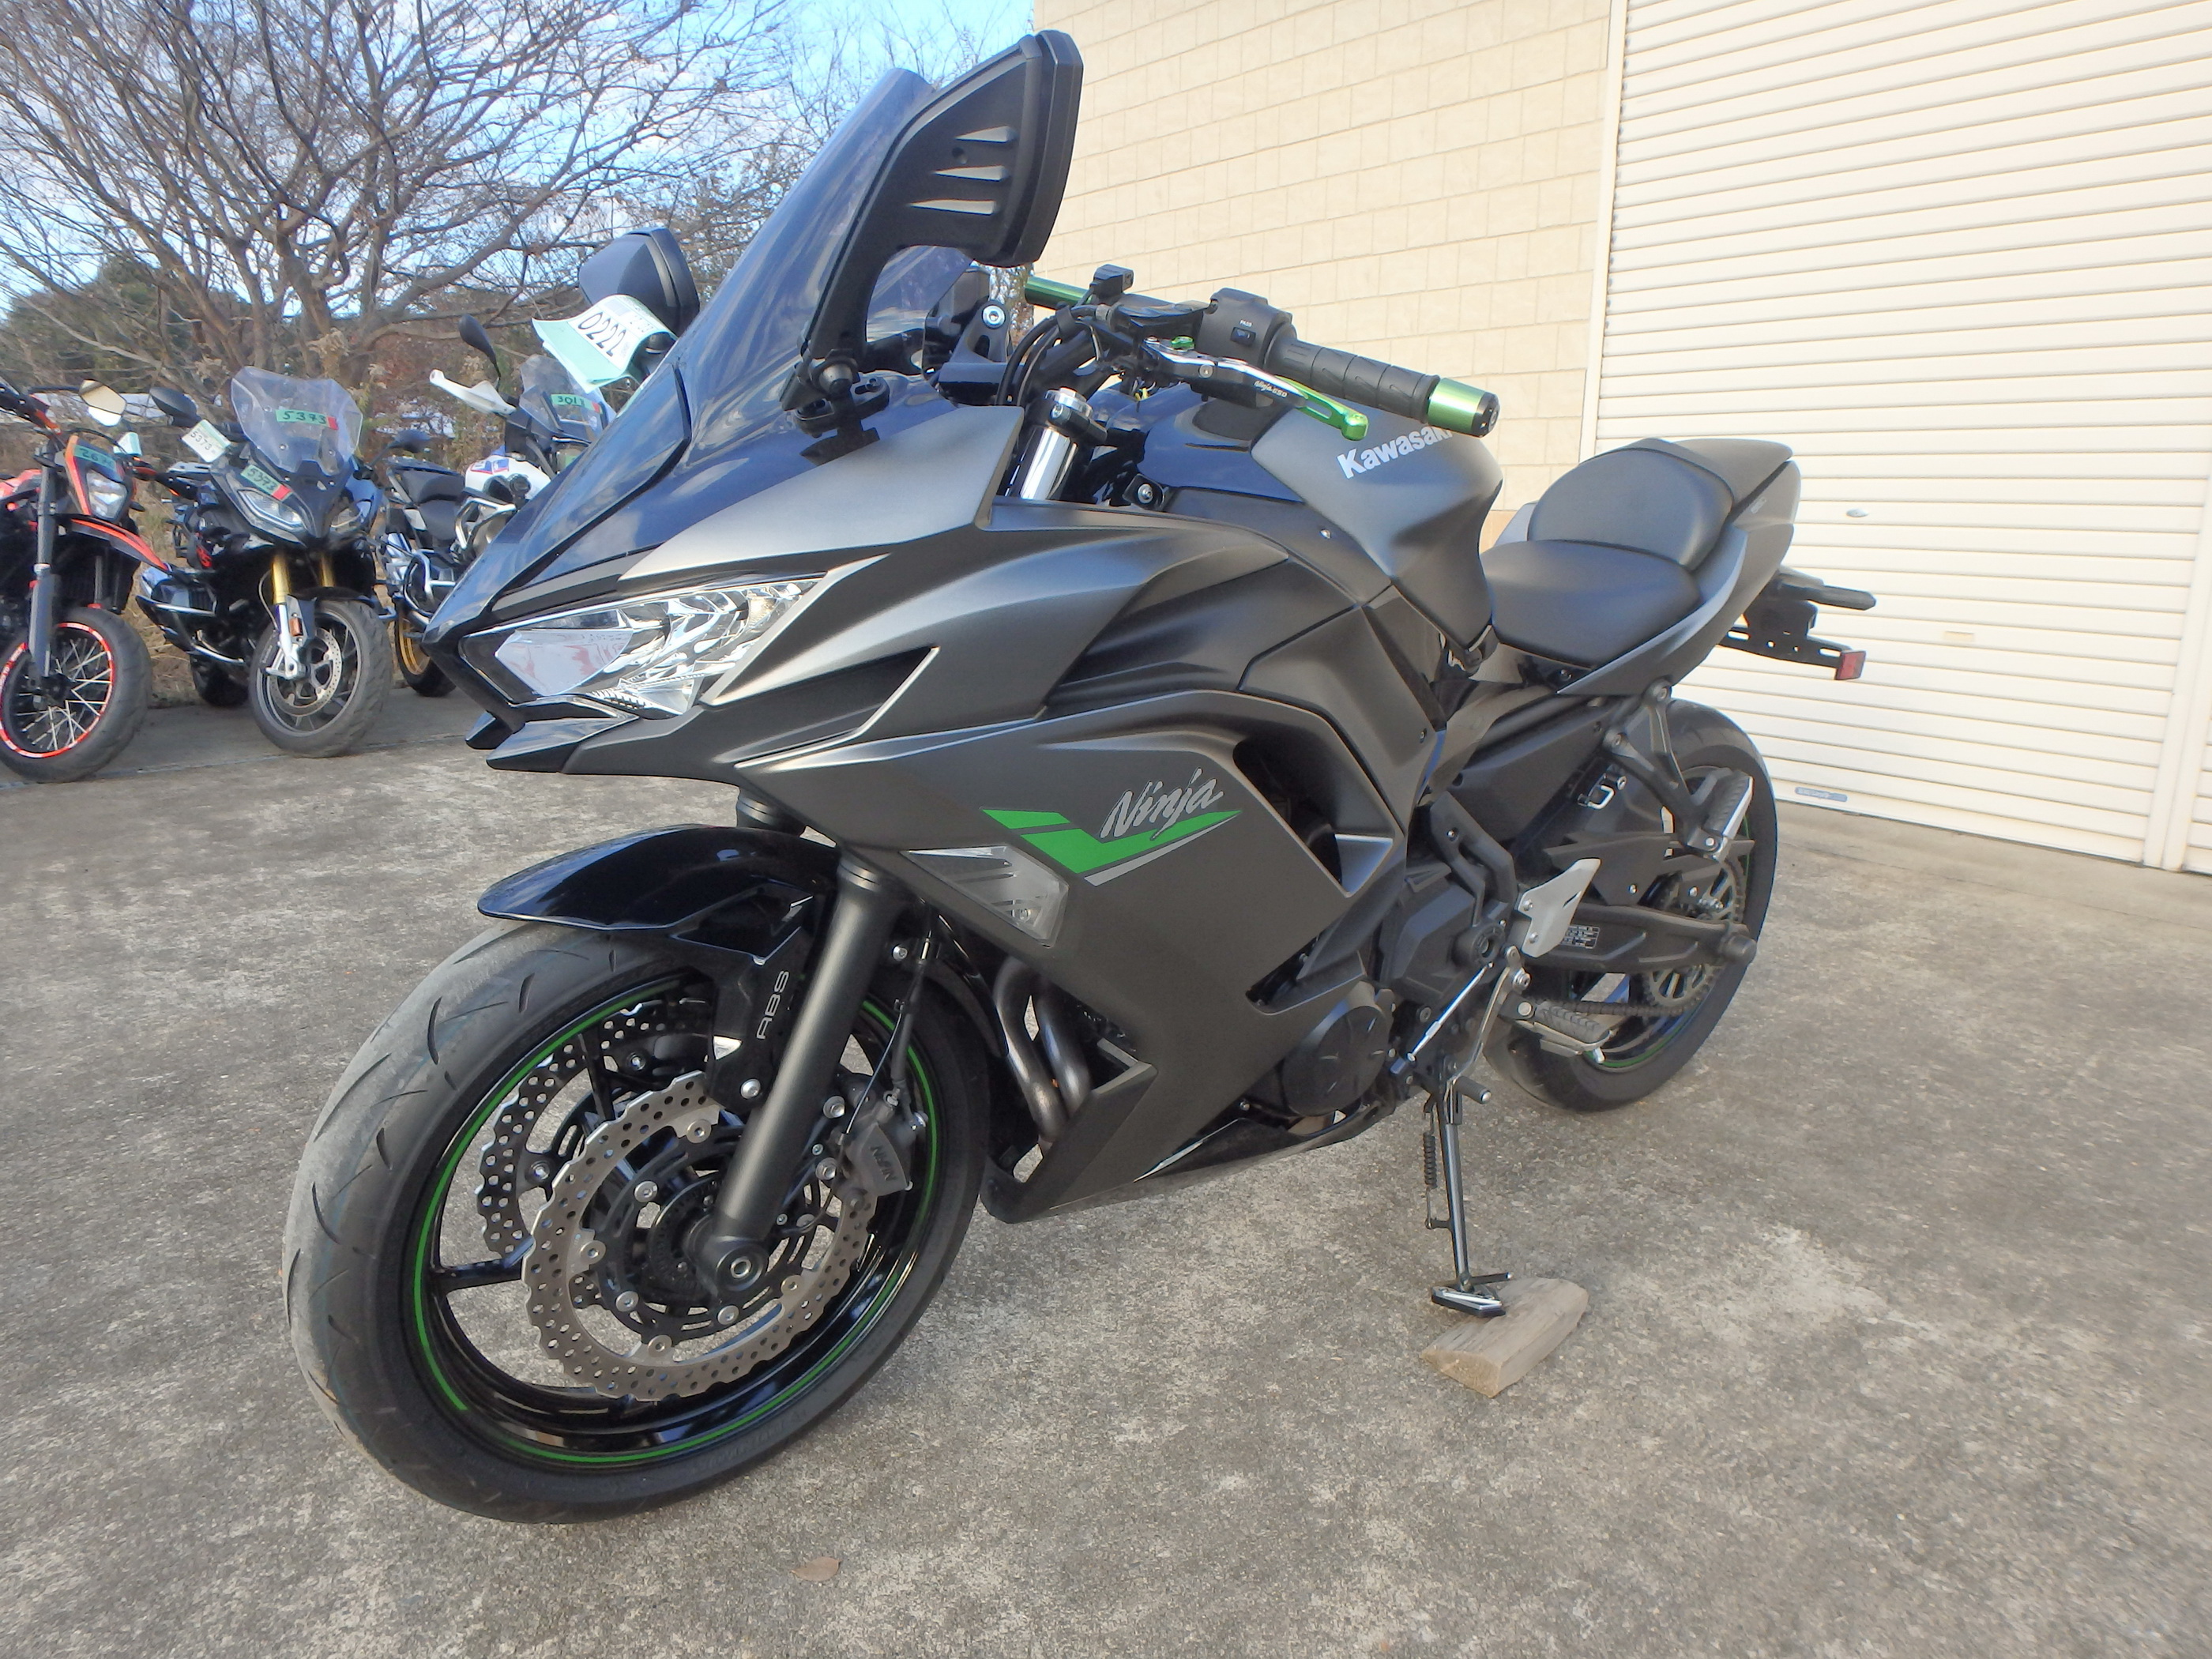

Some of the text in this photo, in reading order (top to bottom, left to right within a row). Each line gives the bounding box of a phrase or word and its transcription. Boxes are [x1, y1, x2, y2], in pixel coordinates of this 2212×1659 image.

[577, 311, 627, 357] 0222
[282, 410, 327, 425] 5373
[190, 431, 213, 451] 5373
[246, 467, 276, 491] 5373
[1100, 767, 1224, 841] Ninja
[756, 970, 789, 1040] ABS
